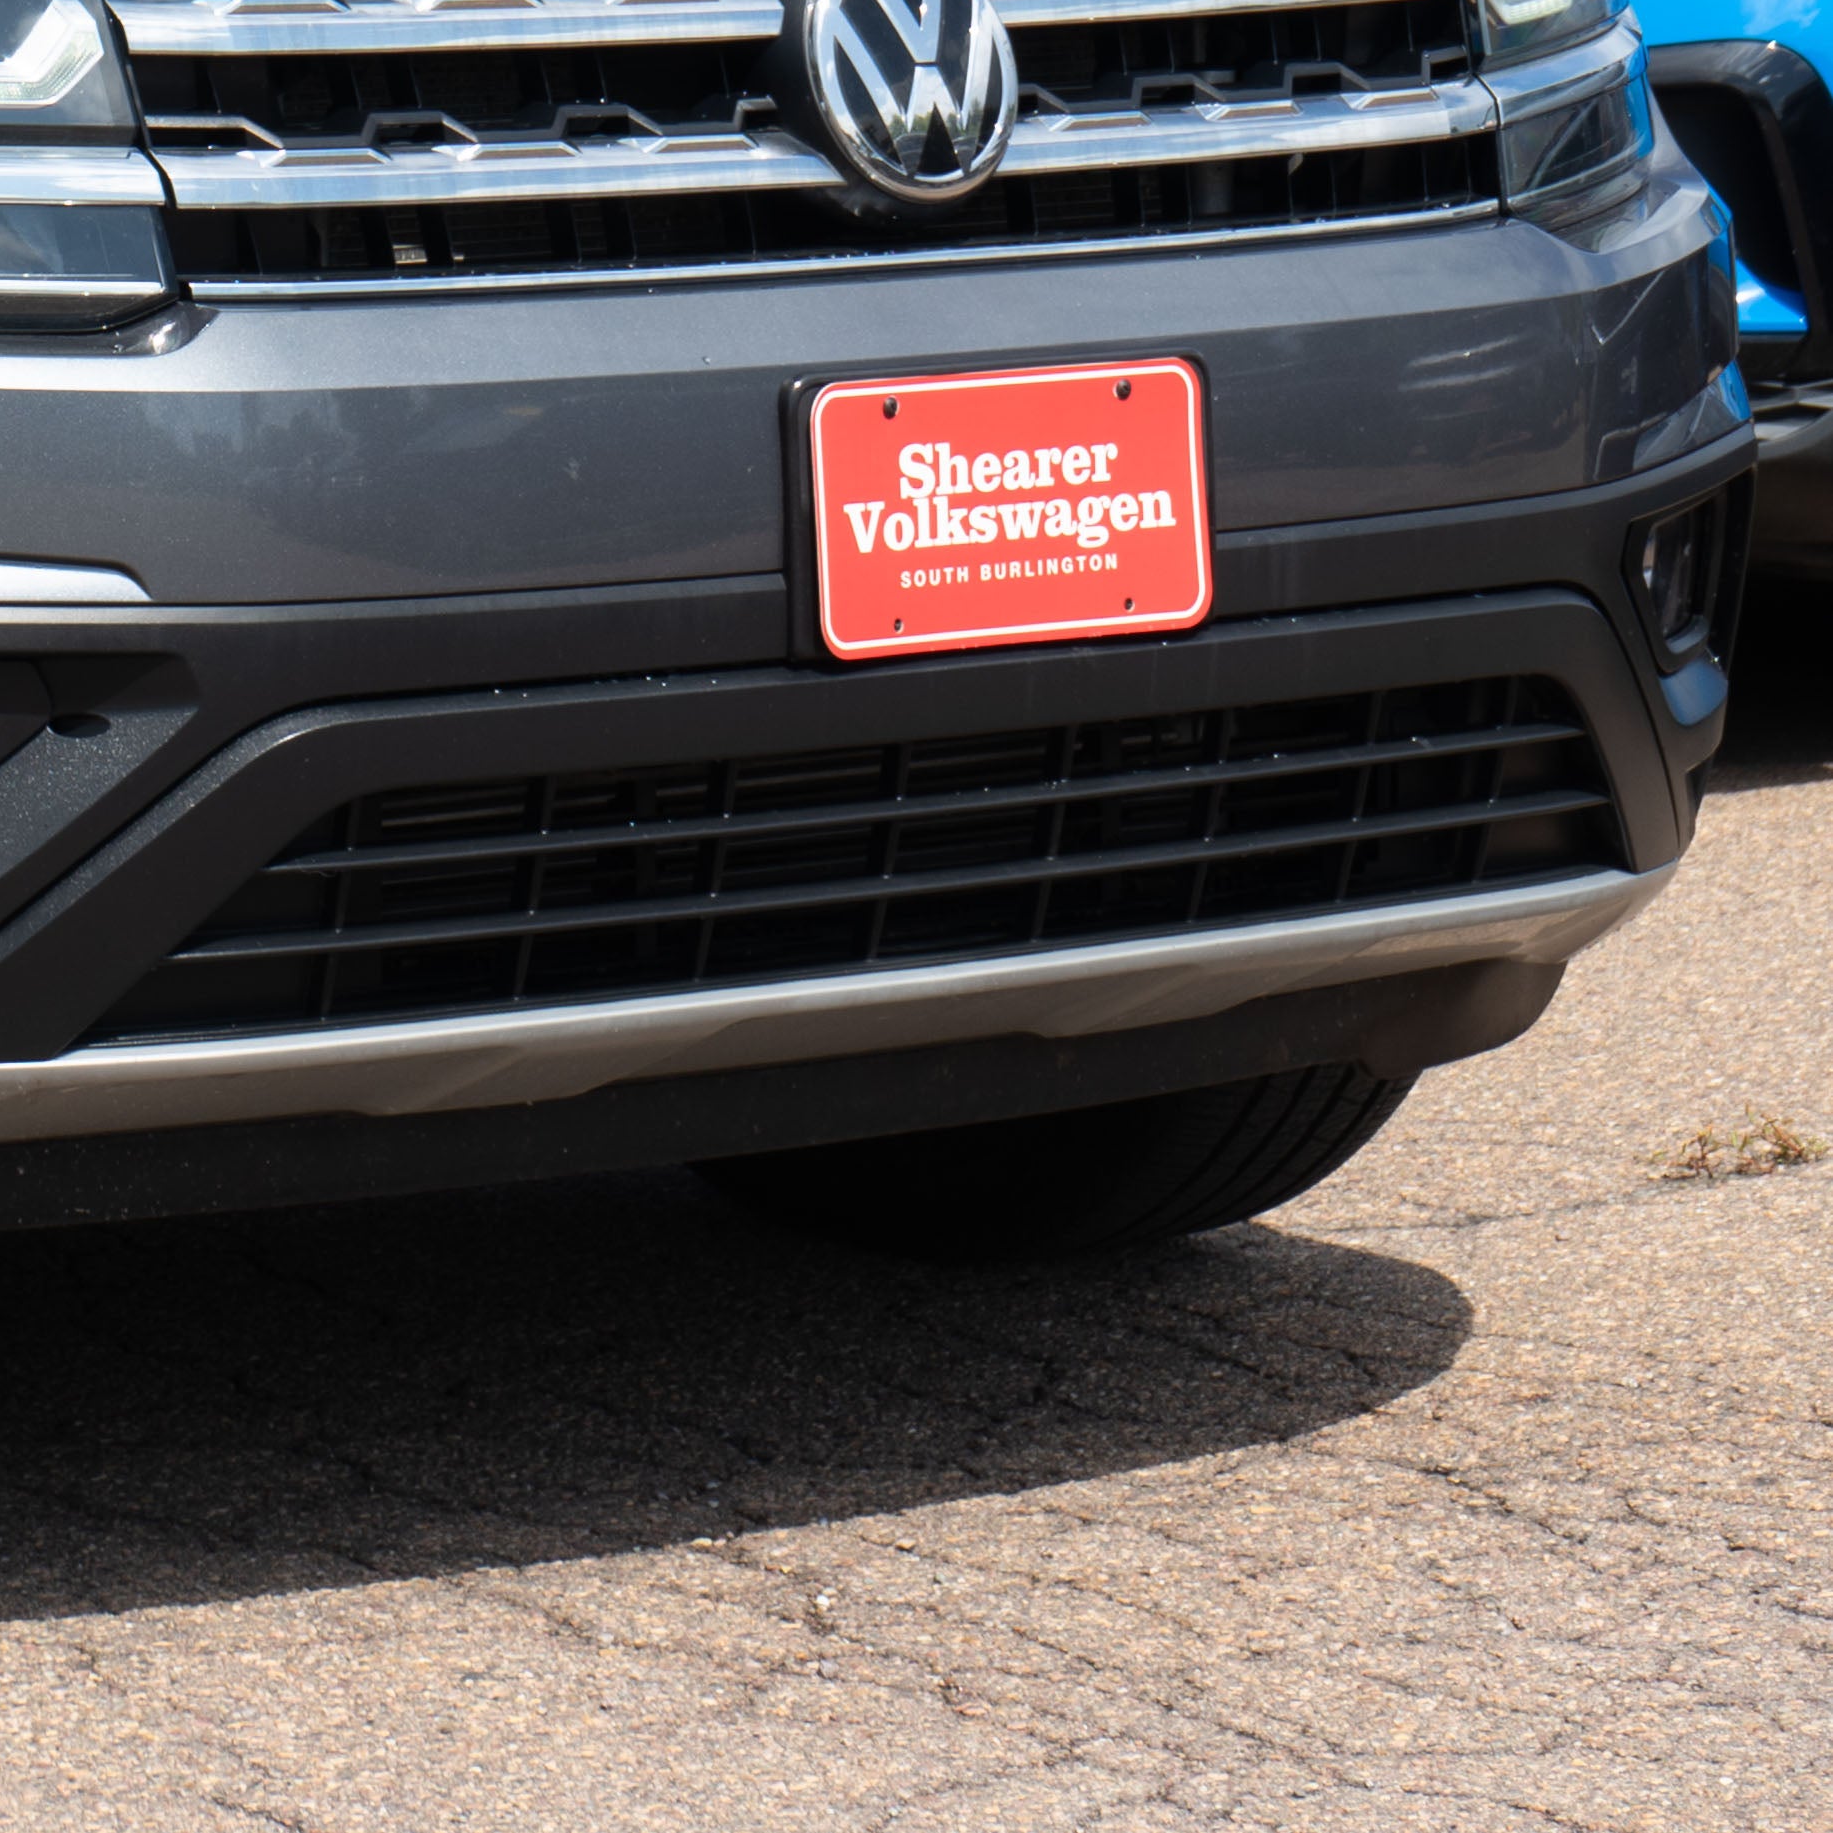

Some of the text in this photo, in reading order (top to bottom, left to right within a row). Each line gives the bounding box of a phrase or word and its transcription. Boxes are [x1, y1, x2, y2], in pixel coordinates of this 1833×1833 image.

[898, 442, 1118, 501] Shearer
[843, 489, 1177, 554] Volkswagen
[900, 553, 1118, 589] SOUTH BURLINGTON
